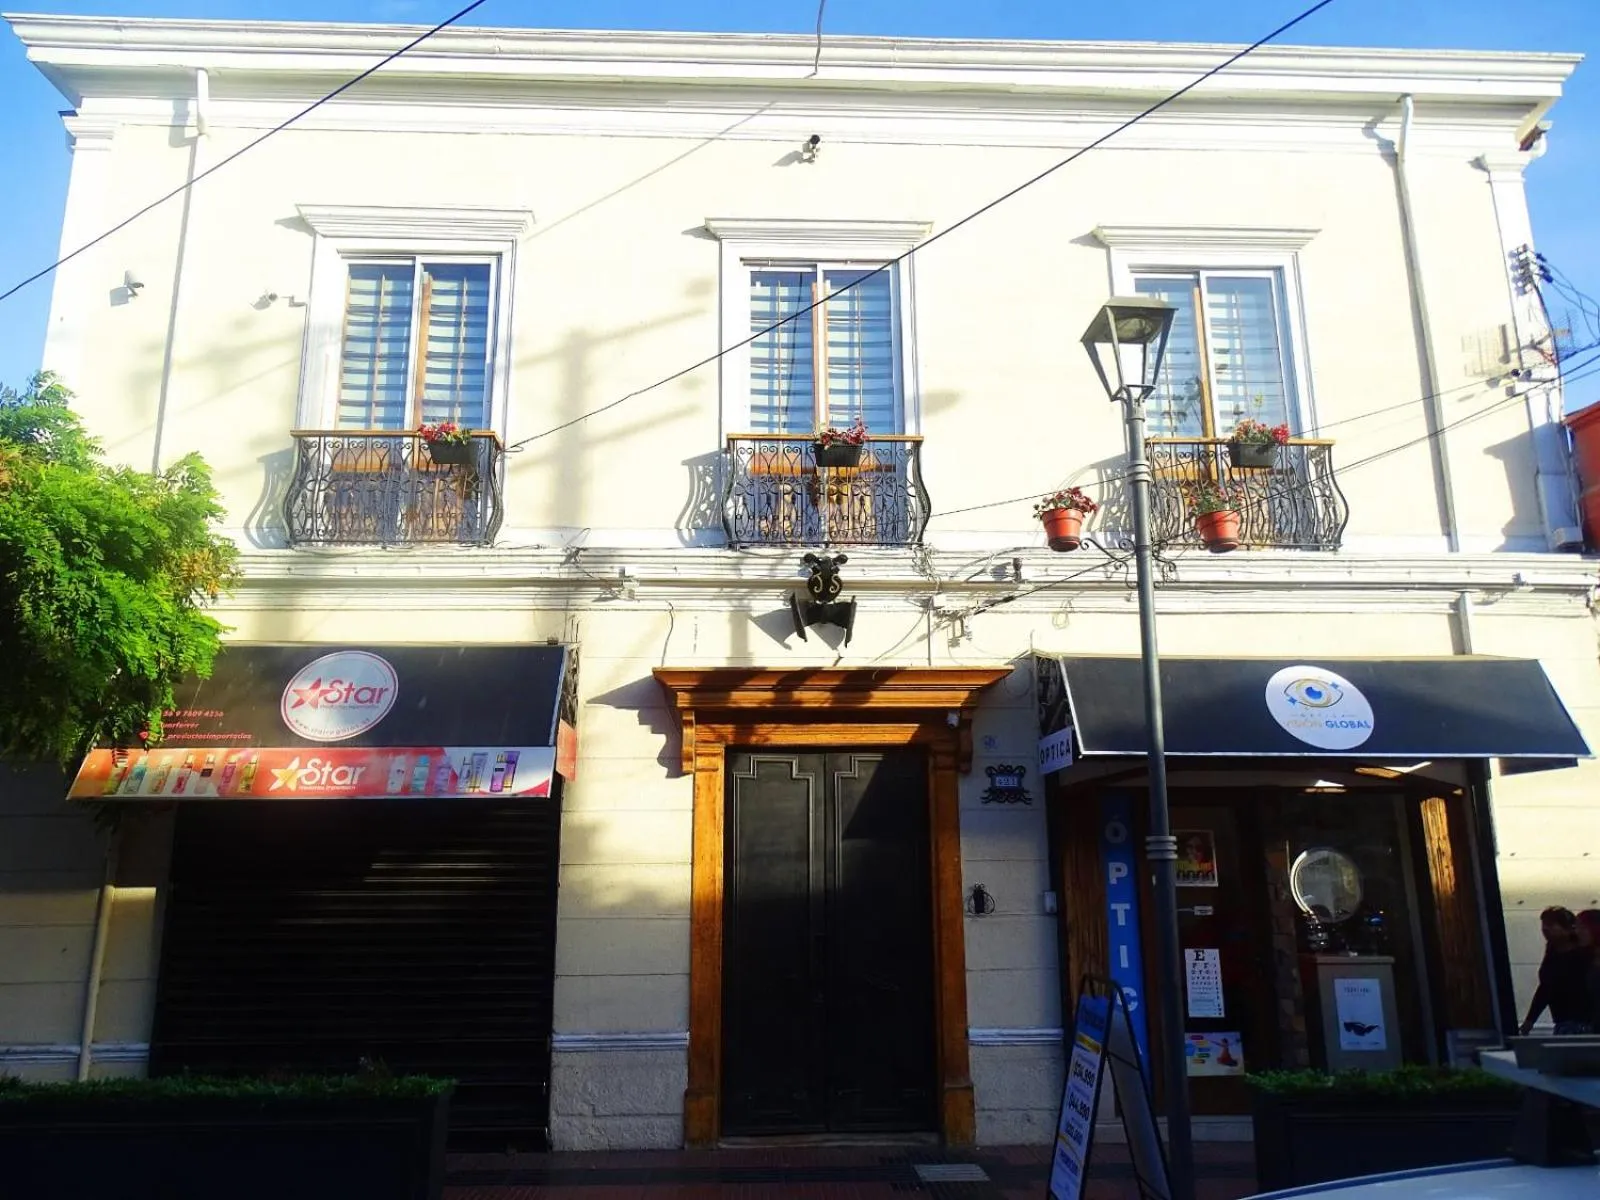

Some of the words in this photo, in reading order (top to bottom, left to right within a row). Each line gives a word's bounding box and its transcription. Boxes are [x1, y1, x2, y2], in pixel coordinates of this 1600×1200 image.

[323, 680, 389, 704] Star
[1325, 720, 1372, 729] GLOBAL
[300, 757, 367, 786] Star
